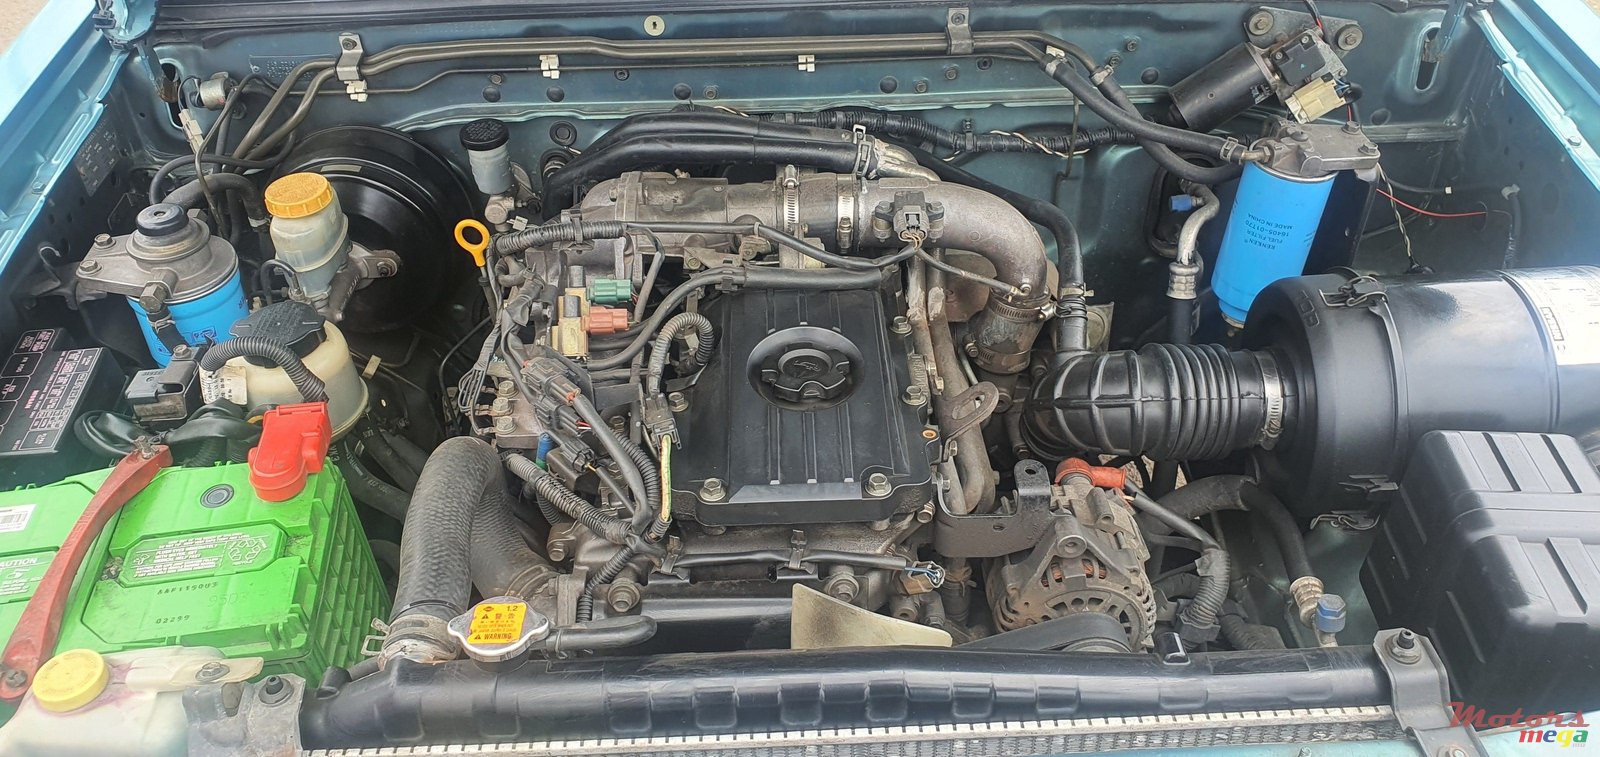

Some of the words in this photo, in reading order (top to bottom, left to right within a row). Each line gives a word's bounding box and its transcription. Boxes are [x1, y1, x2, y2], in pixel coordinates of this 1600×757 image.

[1248, 213, 1266, 224] CHINA
[1275, 222, 1293, 230] MADE
[1246, 229, 1267, 241] FILTER
[0, 558, 37, 568] AUTION
